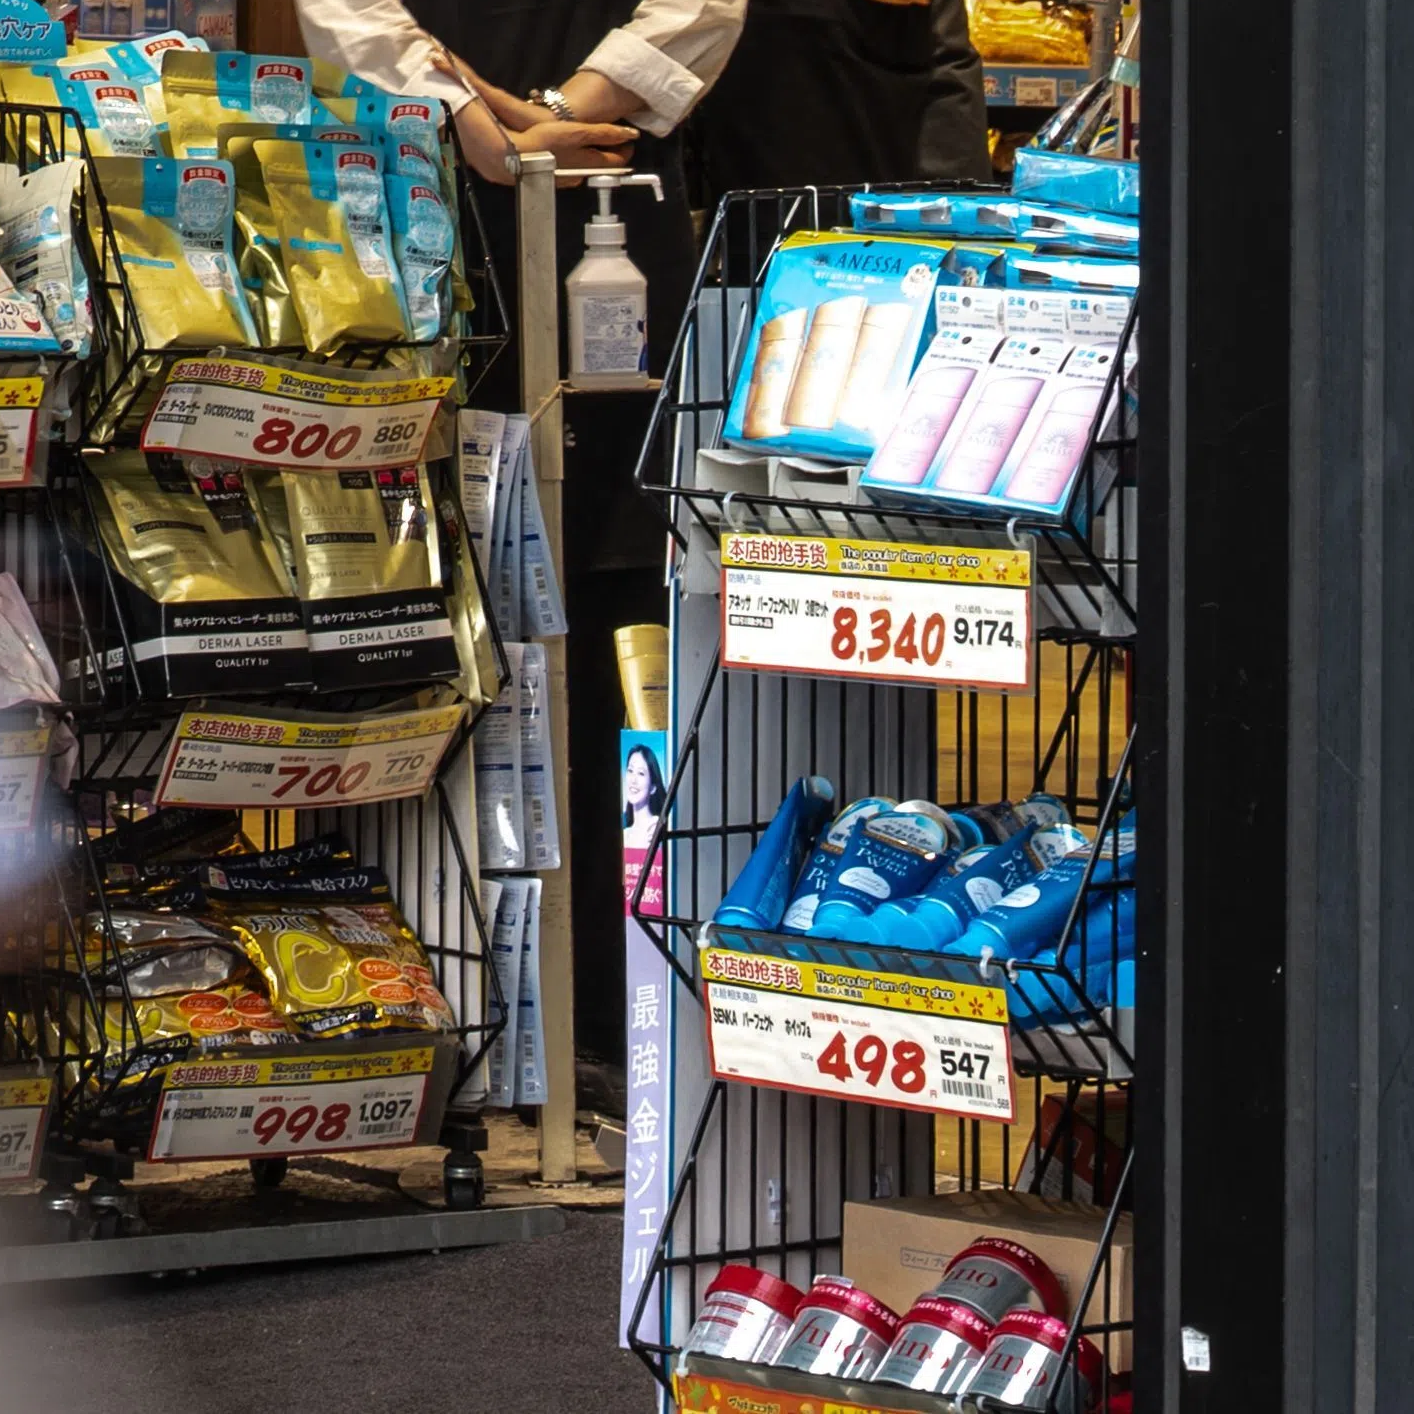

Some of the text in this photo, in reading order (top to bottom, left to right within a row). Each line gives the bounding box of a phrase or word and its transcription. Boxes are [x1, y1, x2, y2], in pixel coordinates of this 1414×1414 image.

[834, 252, 904, 275] ANESSA
[252, 417, 362, 461] 800
[372, 422, 417, 444] 880
[728, 538, 827, 568] 本店的抢手货
[841, 545, 980, 568] The popular item of our shop
[198, 634, 284, 650] DERMA LASER
[338, 626, 425, 647] DERMA LASER
[830, 605, 946, 667] 8,340
[953, 617, 1015, 648] 9,174
[215, 657, 255, 669] QUALITY
[357, 650, 399, 663] QUALITY
[187, 718, 286, 744] 本店的抢手货
[385, 754, 425, 774] 770
[271, 760, 373, 799] 700
[310, 874, 369, 891] 配合マスク
[708, 953, 802, 990] 本店的抢手货
[815, 969, 955, 1001] The popular item of our shop
[712, 1007, 738, 1026] SENKA
[171, 1062, 261, 1086] 本店的抢手货
[815, 1030, 927, 1095] 498
[939, 1049, 991, 1081] 547
[252, 1102, 352, 1147] 998
[629, 982, 661, 1286] 最強金ジェル
